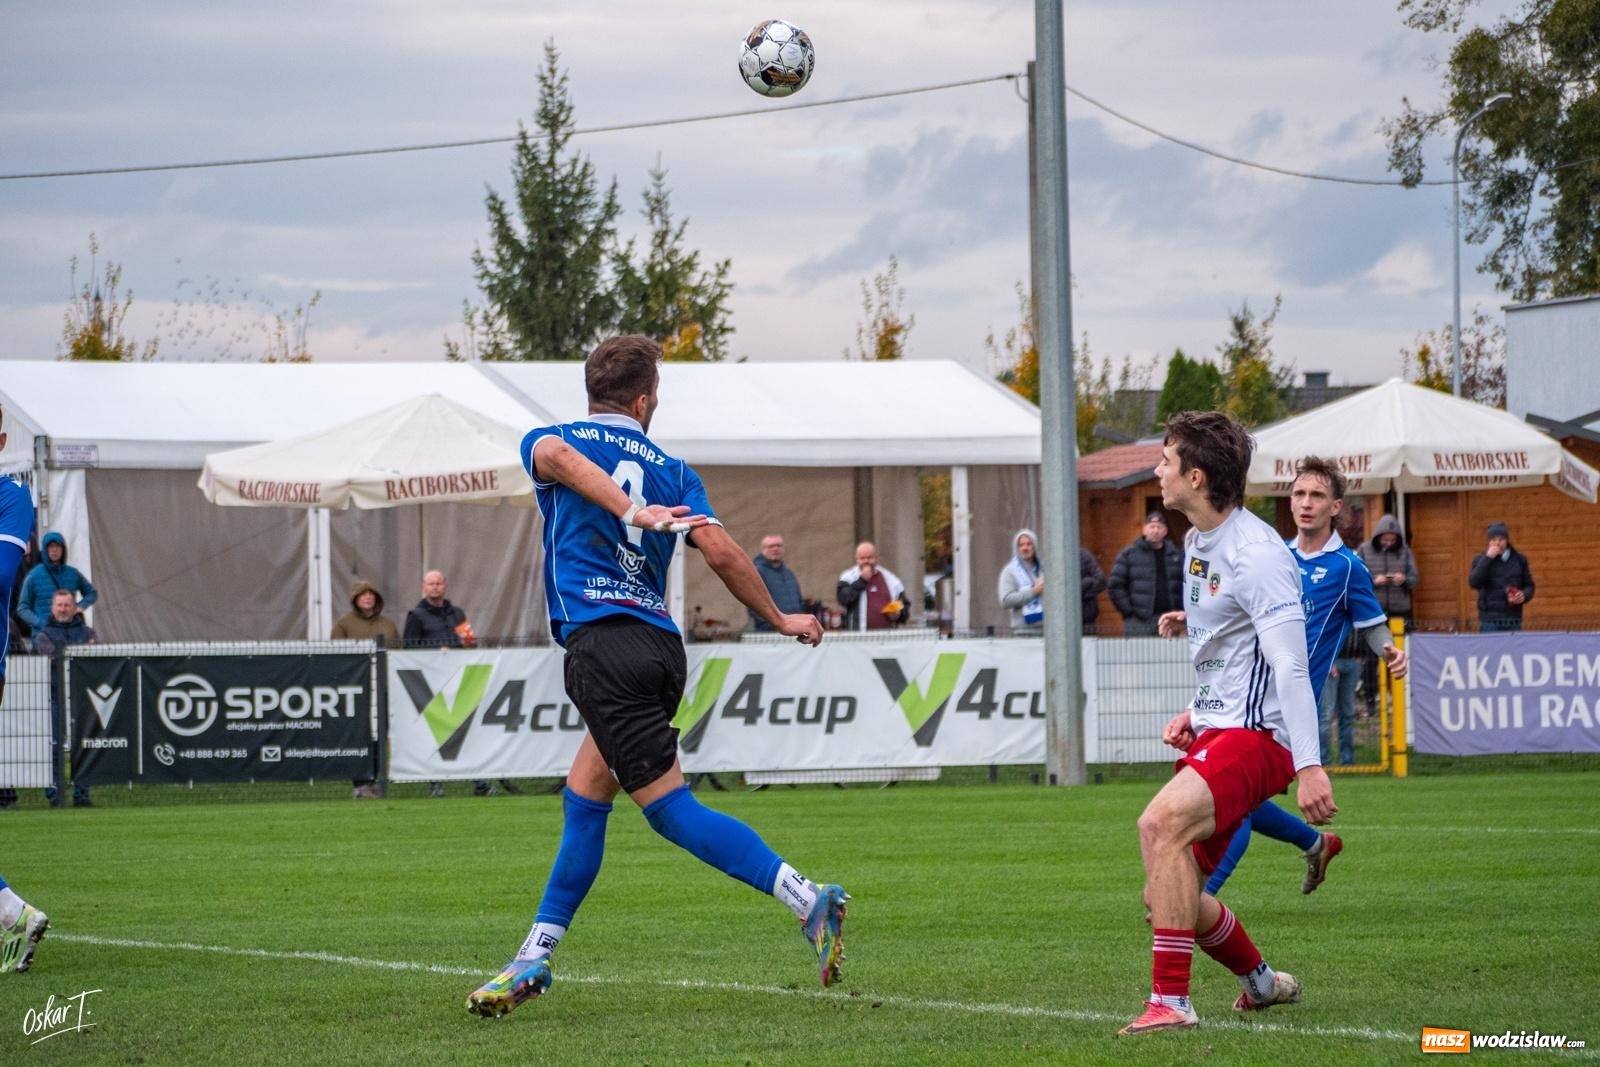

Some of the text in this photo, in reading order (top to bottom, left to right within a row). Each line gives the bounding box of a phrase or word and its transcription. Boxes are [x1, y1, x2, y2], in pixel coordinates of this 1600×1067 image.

[1433, 451, 1530, 471] RACIBORSKIE
[238, 479, 321, 502] RACIBORSKIE
[384, 470, 499, 501] RACIBORSKIE
[224, 685, 364, 720] SPORT
[871, 653, 1088, 748] V4cu
[396, 664, 586, 761] V4cu
[1440, 694, 1600, 732] UNII RA
[226, 721, 322, 732] oficjalny partner MACRON
[82, 736, 128, 749] macron
[179, 749, 248, 759] +48 888 439 365
[285, 747, 369, 759] sklep@dtsport.com.pl
